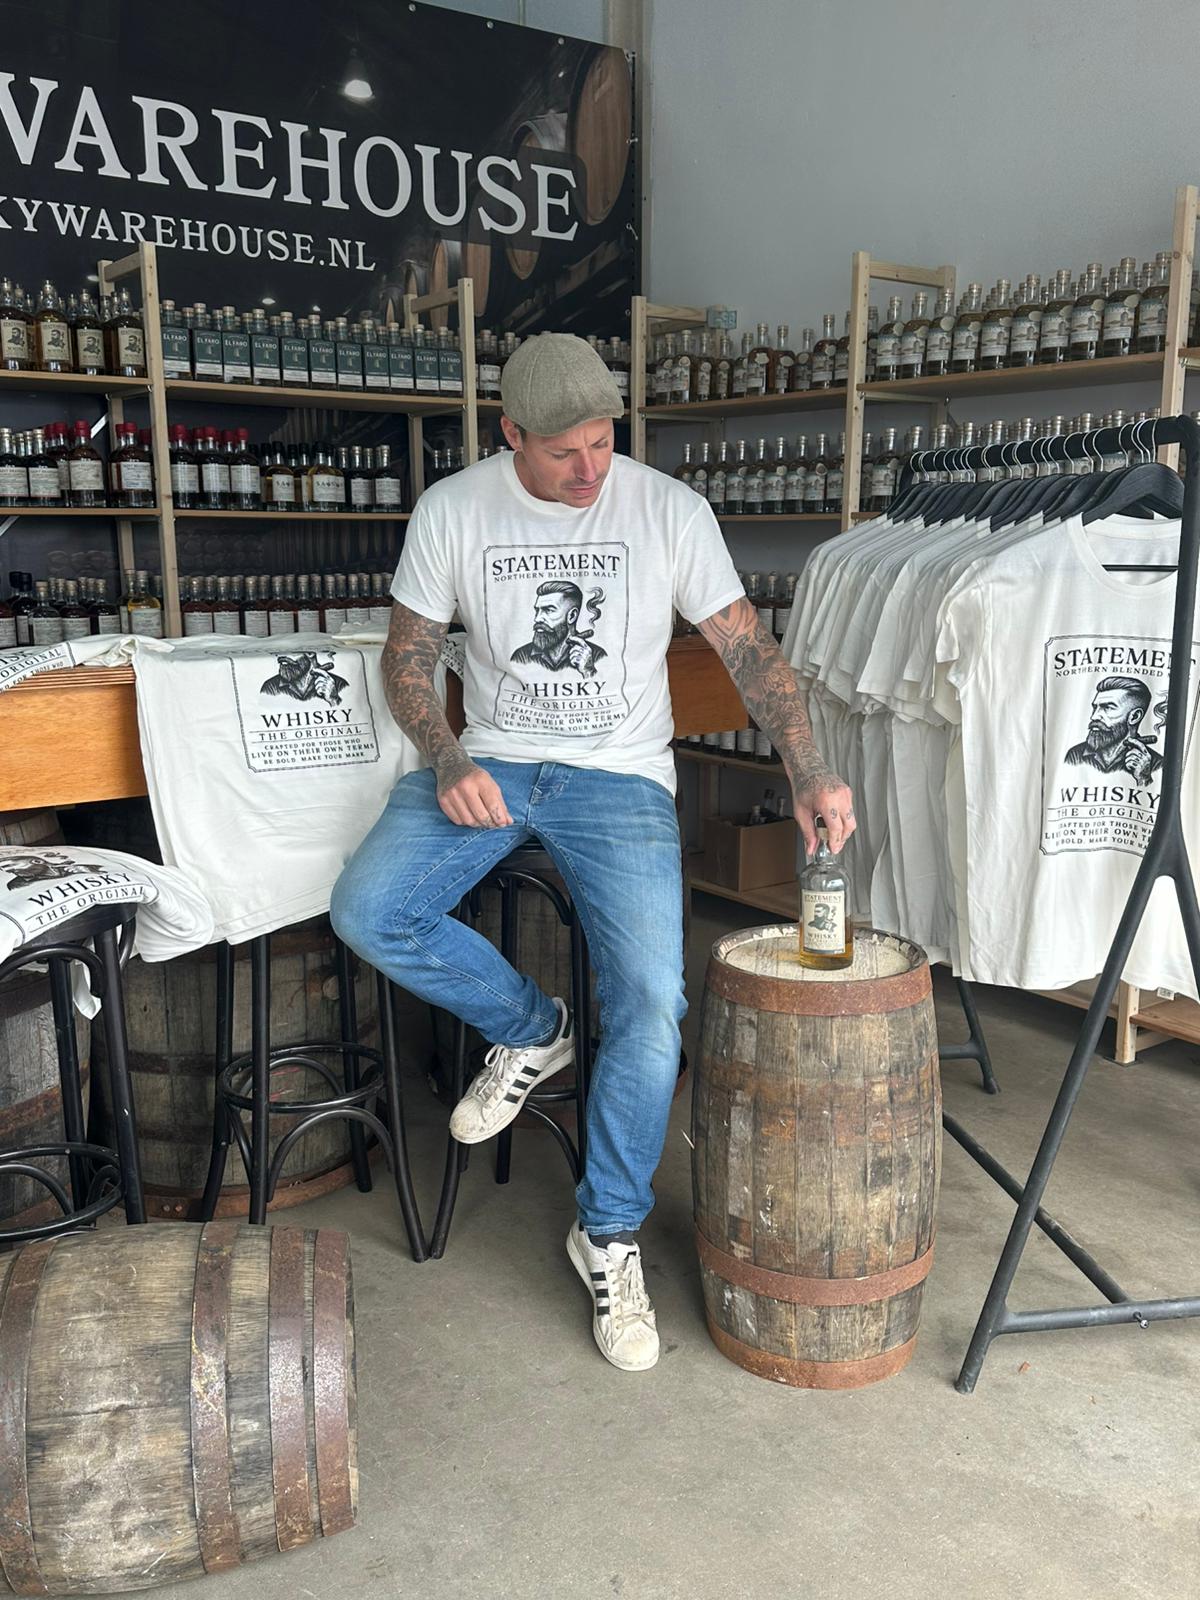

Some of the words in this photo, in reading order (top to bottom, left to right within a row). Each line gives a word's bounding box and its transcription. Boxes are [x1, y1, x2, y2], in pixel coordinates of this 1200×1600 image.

[492, 553, 620, 576] STATEMENT
[494, 572, 544, 583] NORTHERN
[548, 570, 590, 578] BLENDED
[593, 571, 617, 579] MALT
[0, 648, 61, 678] ORIGINAL
[1054, 646, 1196, 671] STATEME
[1055, 665, 1108, 678] NORTHERN
[1112, 666, 1163, 678] BLENDED
[511, 694, 537, 706] THE
[542, 698, 612, 710] ORIGINAL
[261, 709, 352, 728] WHISKY
[498, 710, 515, 720] LIVE
[519, 714, 531, 722] ON
[536, 718, 564, 726] THEIR
[595, 712, 626, 722] TERMS
[510, 706, 543, 717] CRAFTED
[259, 732, 287, 741] THE
[295, 726, 361, 738] ORIGINAL
[252, 750, 272, 759] LIVE
[293, 748, 320, 756] THEIR
[347, 743, 374, 751] TERMS
[1061, 786, 1160, 809] WHISKY
[1057, 808, 1079, 816] THE
[1089, 807, 1155, 823] ORIGINA
[1082, 828, 1109, 836] THEIR
[1114, 828, 1138, 838] OWN
[1110, 821, 1138, 830] THOSE
[1112, 836, 1135, 846] YOUR
[28, 873, 132, 907] WHISKY
[36, 906, 70, 925] THE
[77, 886, 145, 908] ORIGINAL
